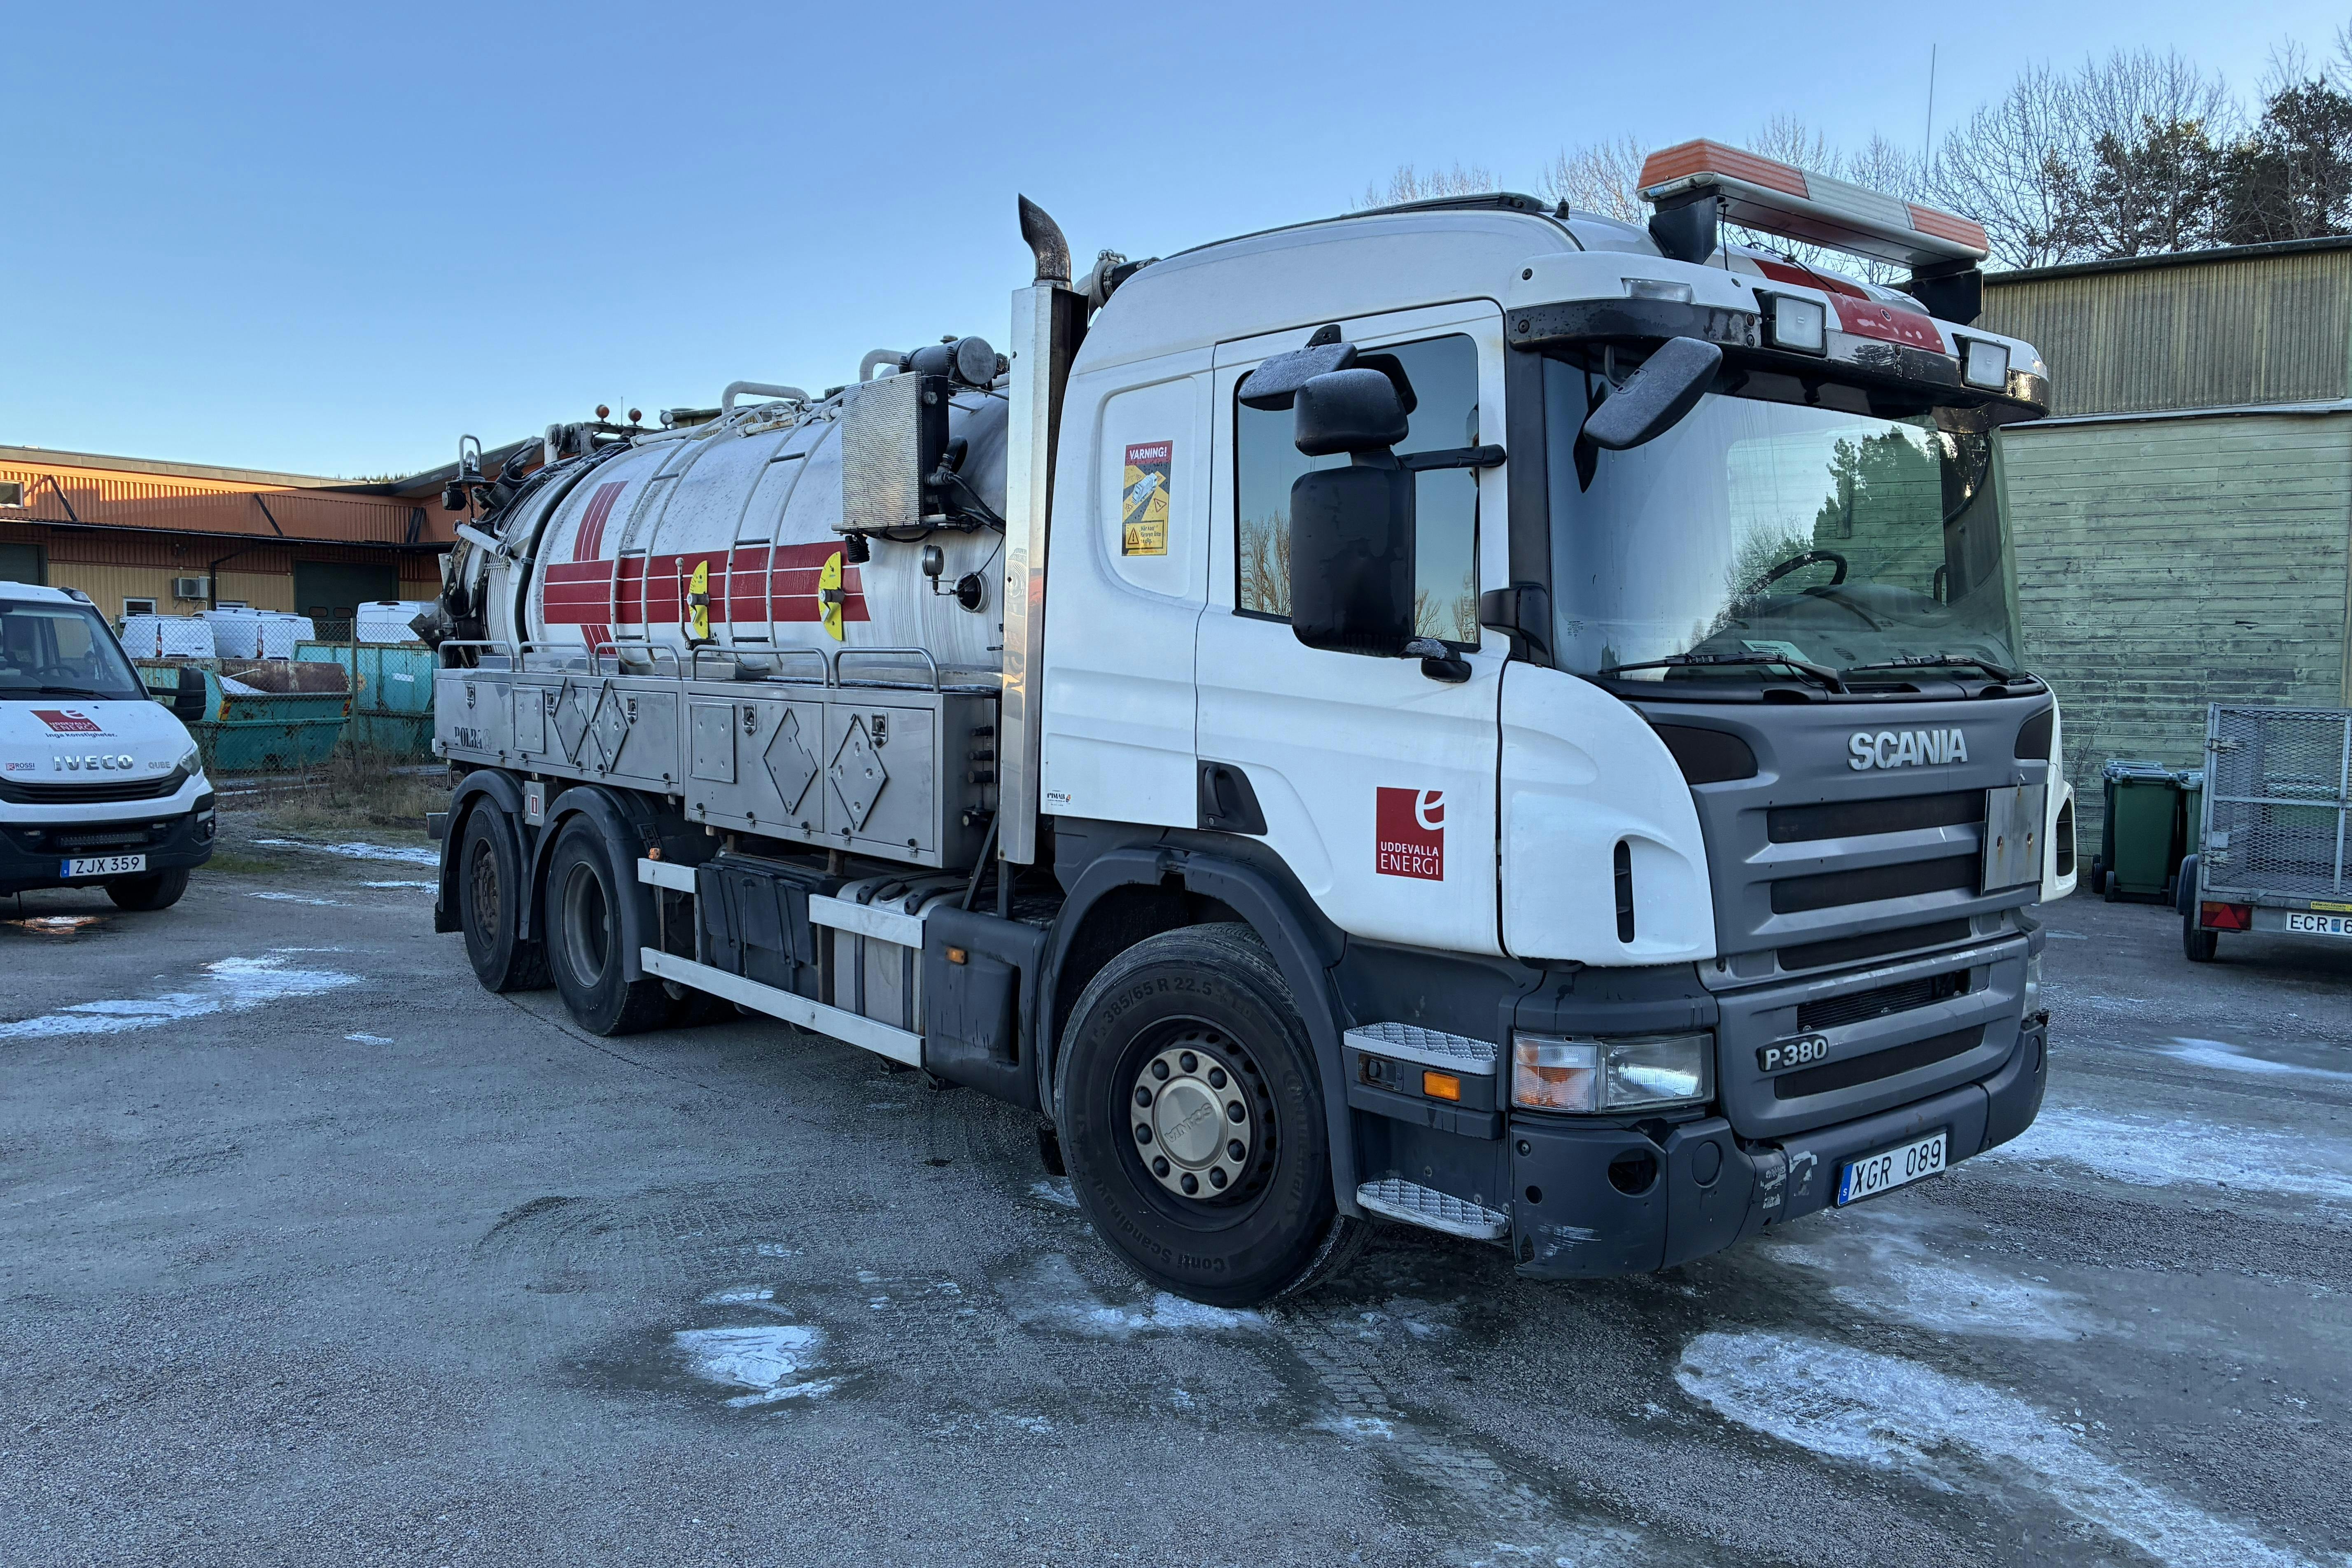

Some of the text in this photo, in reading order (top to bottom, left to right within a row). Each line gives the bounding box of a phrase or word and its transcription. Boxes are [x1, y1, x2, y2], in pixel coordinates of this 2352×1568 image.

[1129, 446, 1167, 460] VARNING!
[1848, 728, 1968, 771] SCANIA
[52, 754, 134, 771] IVECO
[148, 761, 172, 769] QUBE
[1380, 841, 1439, 857] UDDEVALLA
[75, 856, 140, 874] ZJX 359
[1381, 853, 1439, 875] ENERGI
[2291, 914, 2328, 932] ECR
[1103, 981, 1153, 1024] 385/65
[1156, 977, 1169, 992] R
[1174, 977, 1212, 996] 22.5
[1164, 1102, 1213, 1143] SCANIA
[1852, 1139, 1941, 1195] XGR 089
[1843, 1188, 1848, 1196] S
[1177, 1253, 1227, 1273] Conti
